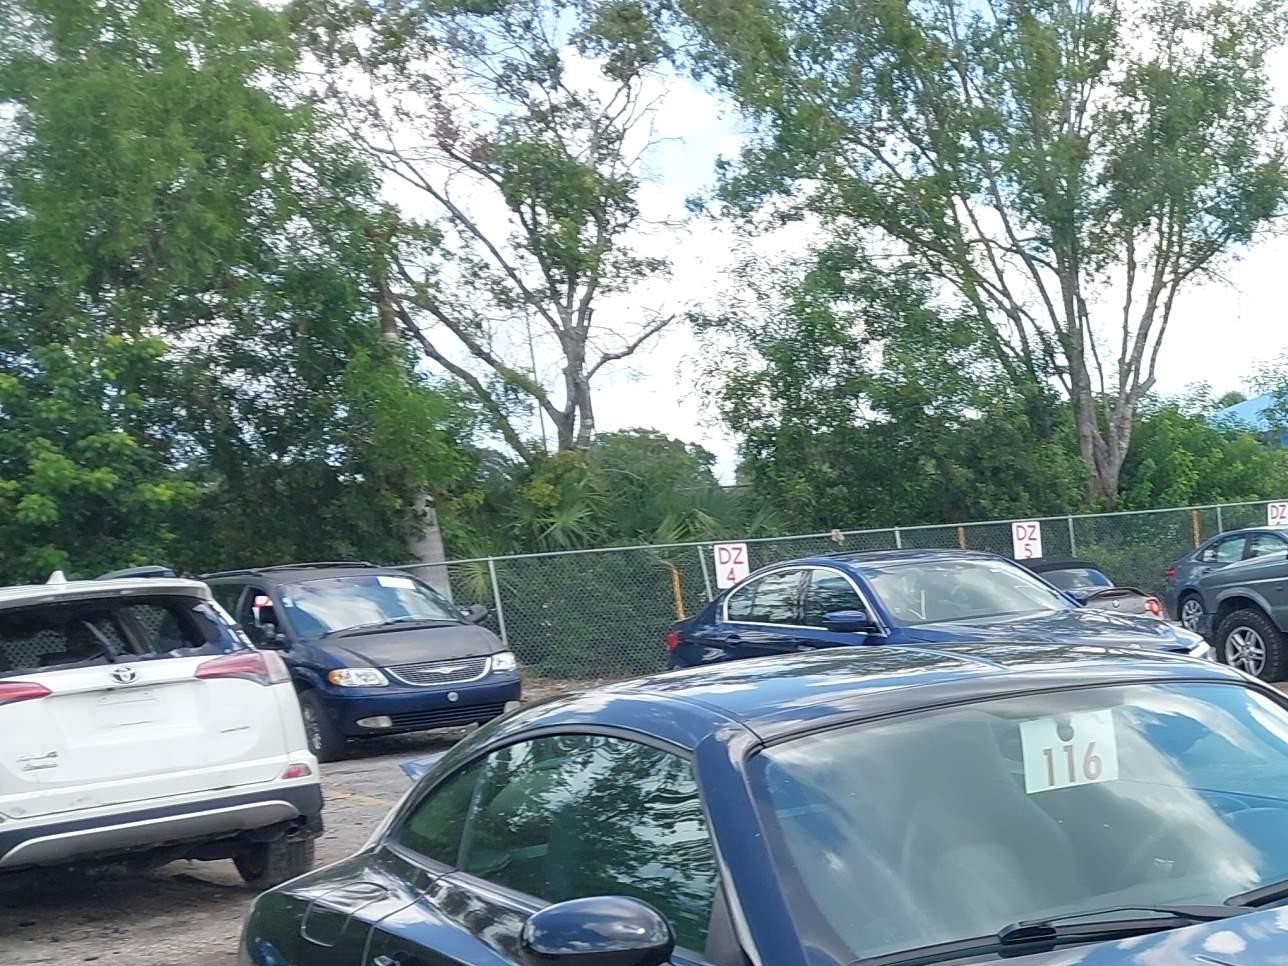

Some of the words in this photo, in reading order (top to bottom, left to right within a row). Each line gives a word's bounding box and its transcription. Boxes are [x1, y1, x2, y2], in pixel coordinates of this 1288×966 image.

[1270, 504, 1287, 519] DZ
[1016, 524, 1037, 541] DZ
[718, 547, 745, 565] DZ
[1024, 543, 1033, 559] 5
[726, 567, 736, 584] 4
[1043, 741, 1102, 786] 116
